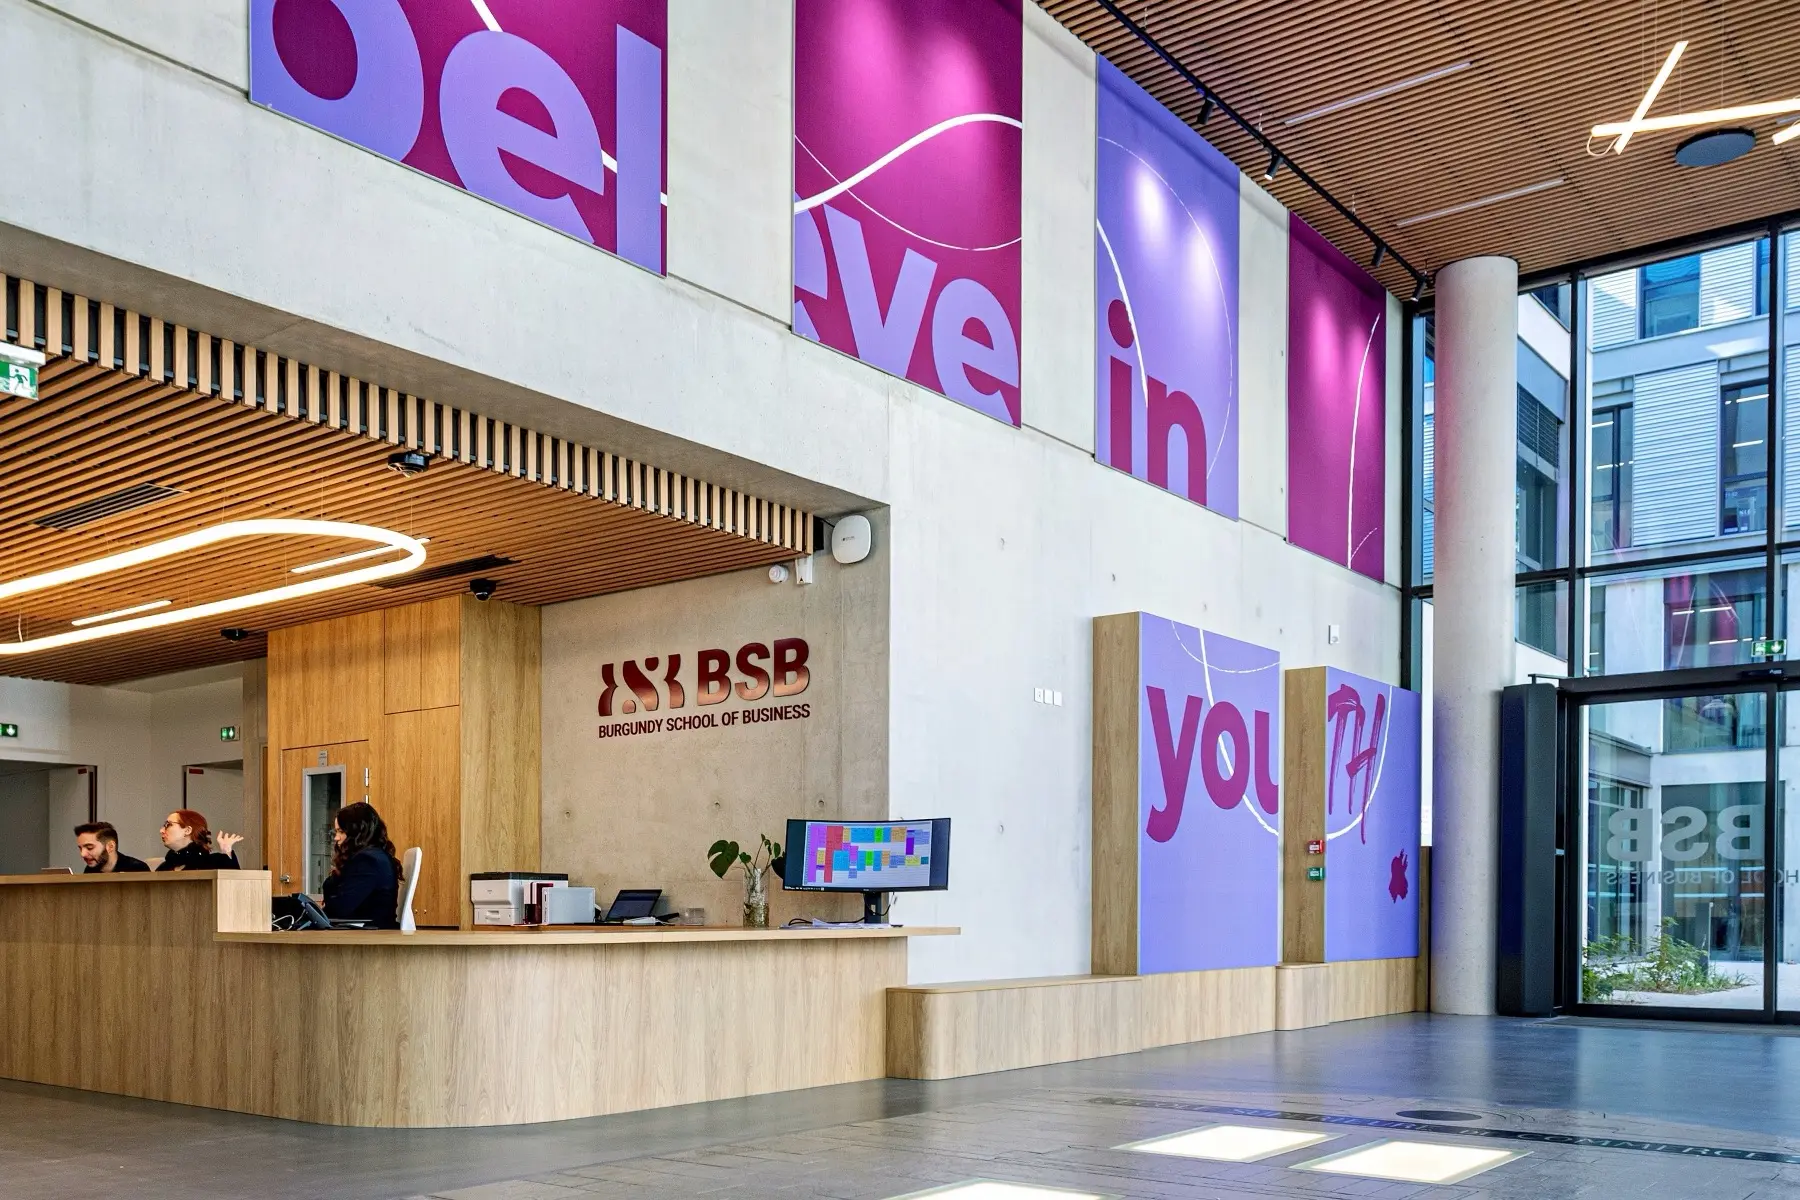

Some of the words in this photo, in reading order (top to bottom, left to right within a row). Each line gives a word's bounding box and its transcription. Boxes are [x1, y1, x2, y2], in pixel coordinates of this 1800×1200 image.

[1107, 299, 1207, 507] in
[697, 638, 810, 706] BSB
[598, 719, 663, 738] BURGUNDY
[666, 714, 718, 731] SCHOOL
[721, 711, 739, 726] OF
[743, 703, 810, 724] BUSINESS
